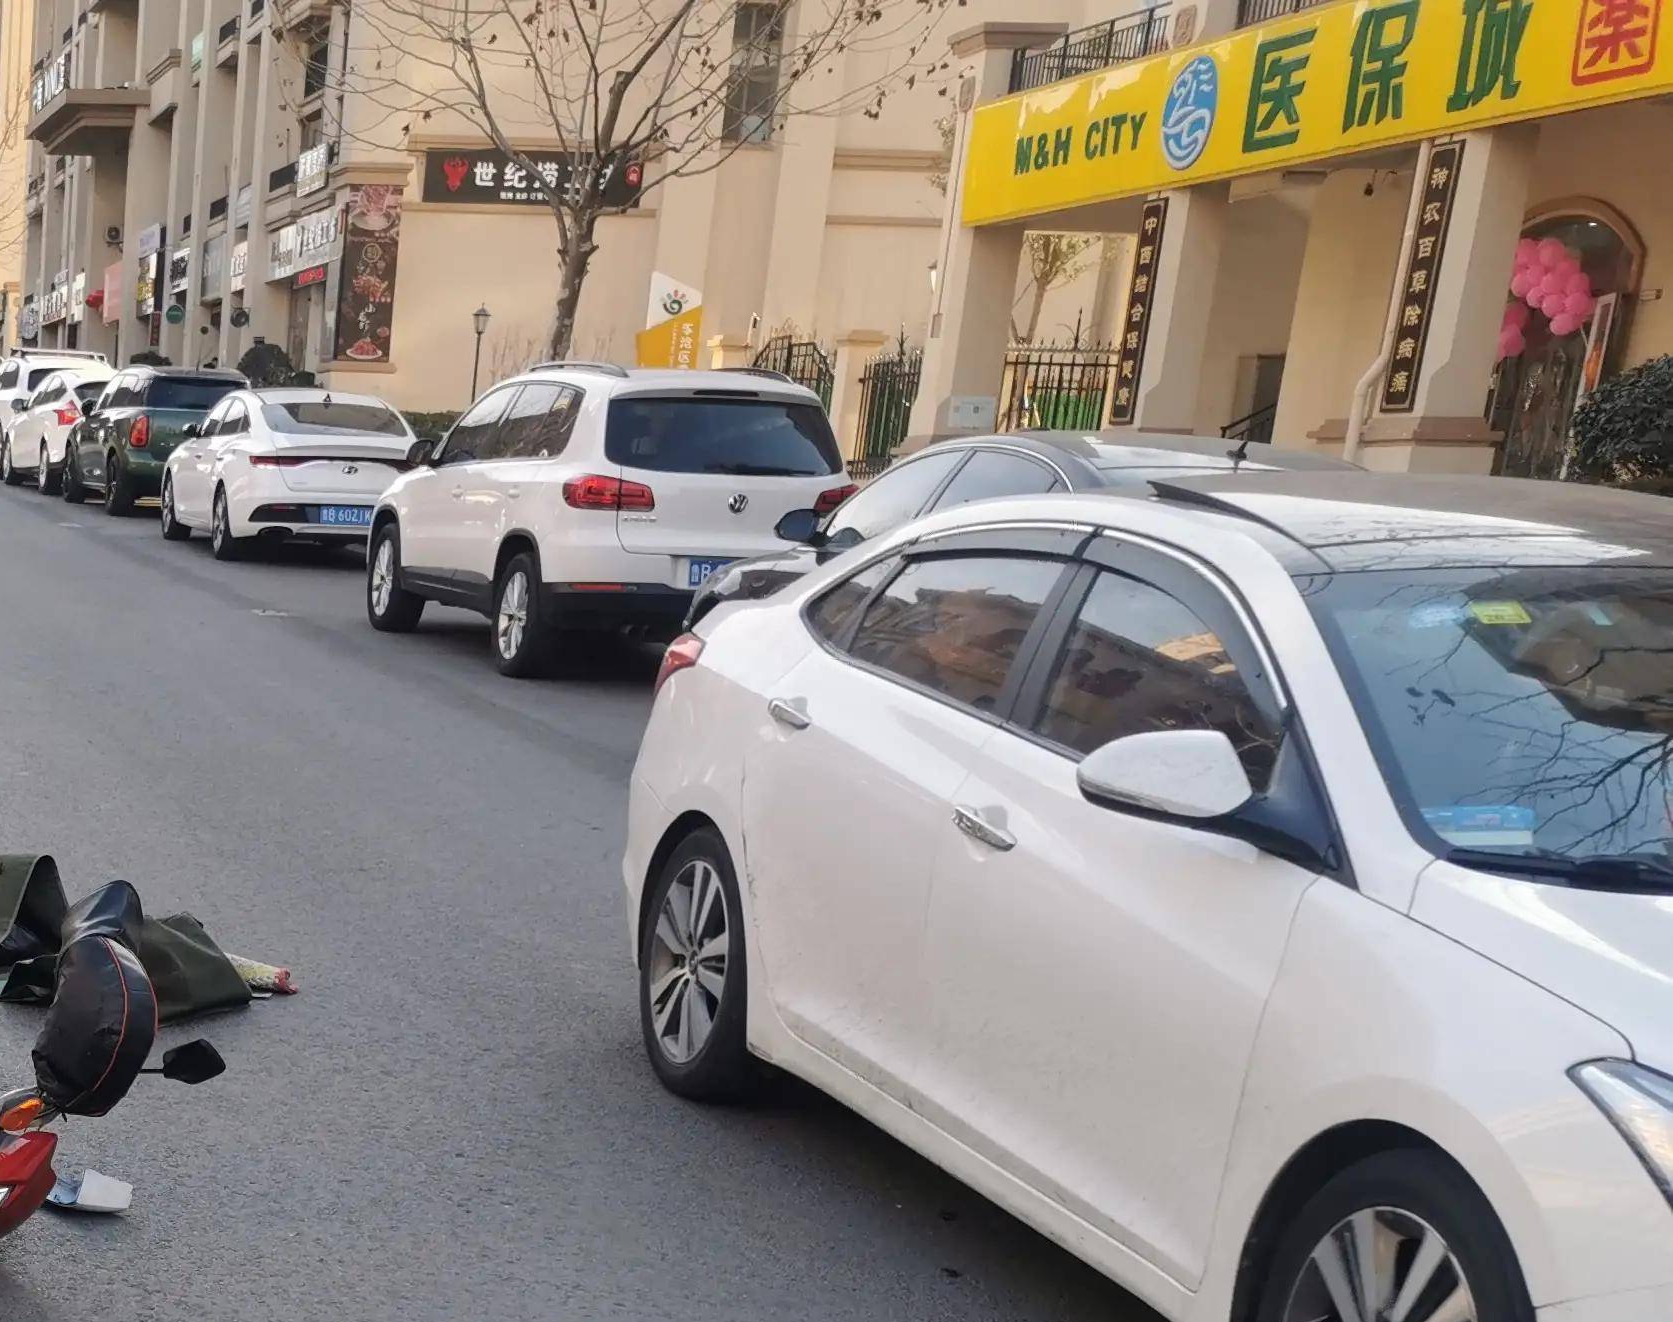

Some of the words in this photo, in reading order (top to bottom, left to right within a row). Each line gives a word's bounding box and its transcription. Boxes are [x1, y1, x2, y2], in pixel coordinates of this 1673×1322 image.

[1242, 0, 1533, 153] 医保城
[1014, 126, 1073, 176] M&H
[1084, 111, 1148, 161] CITY
